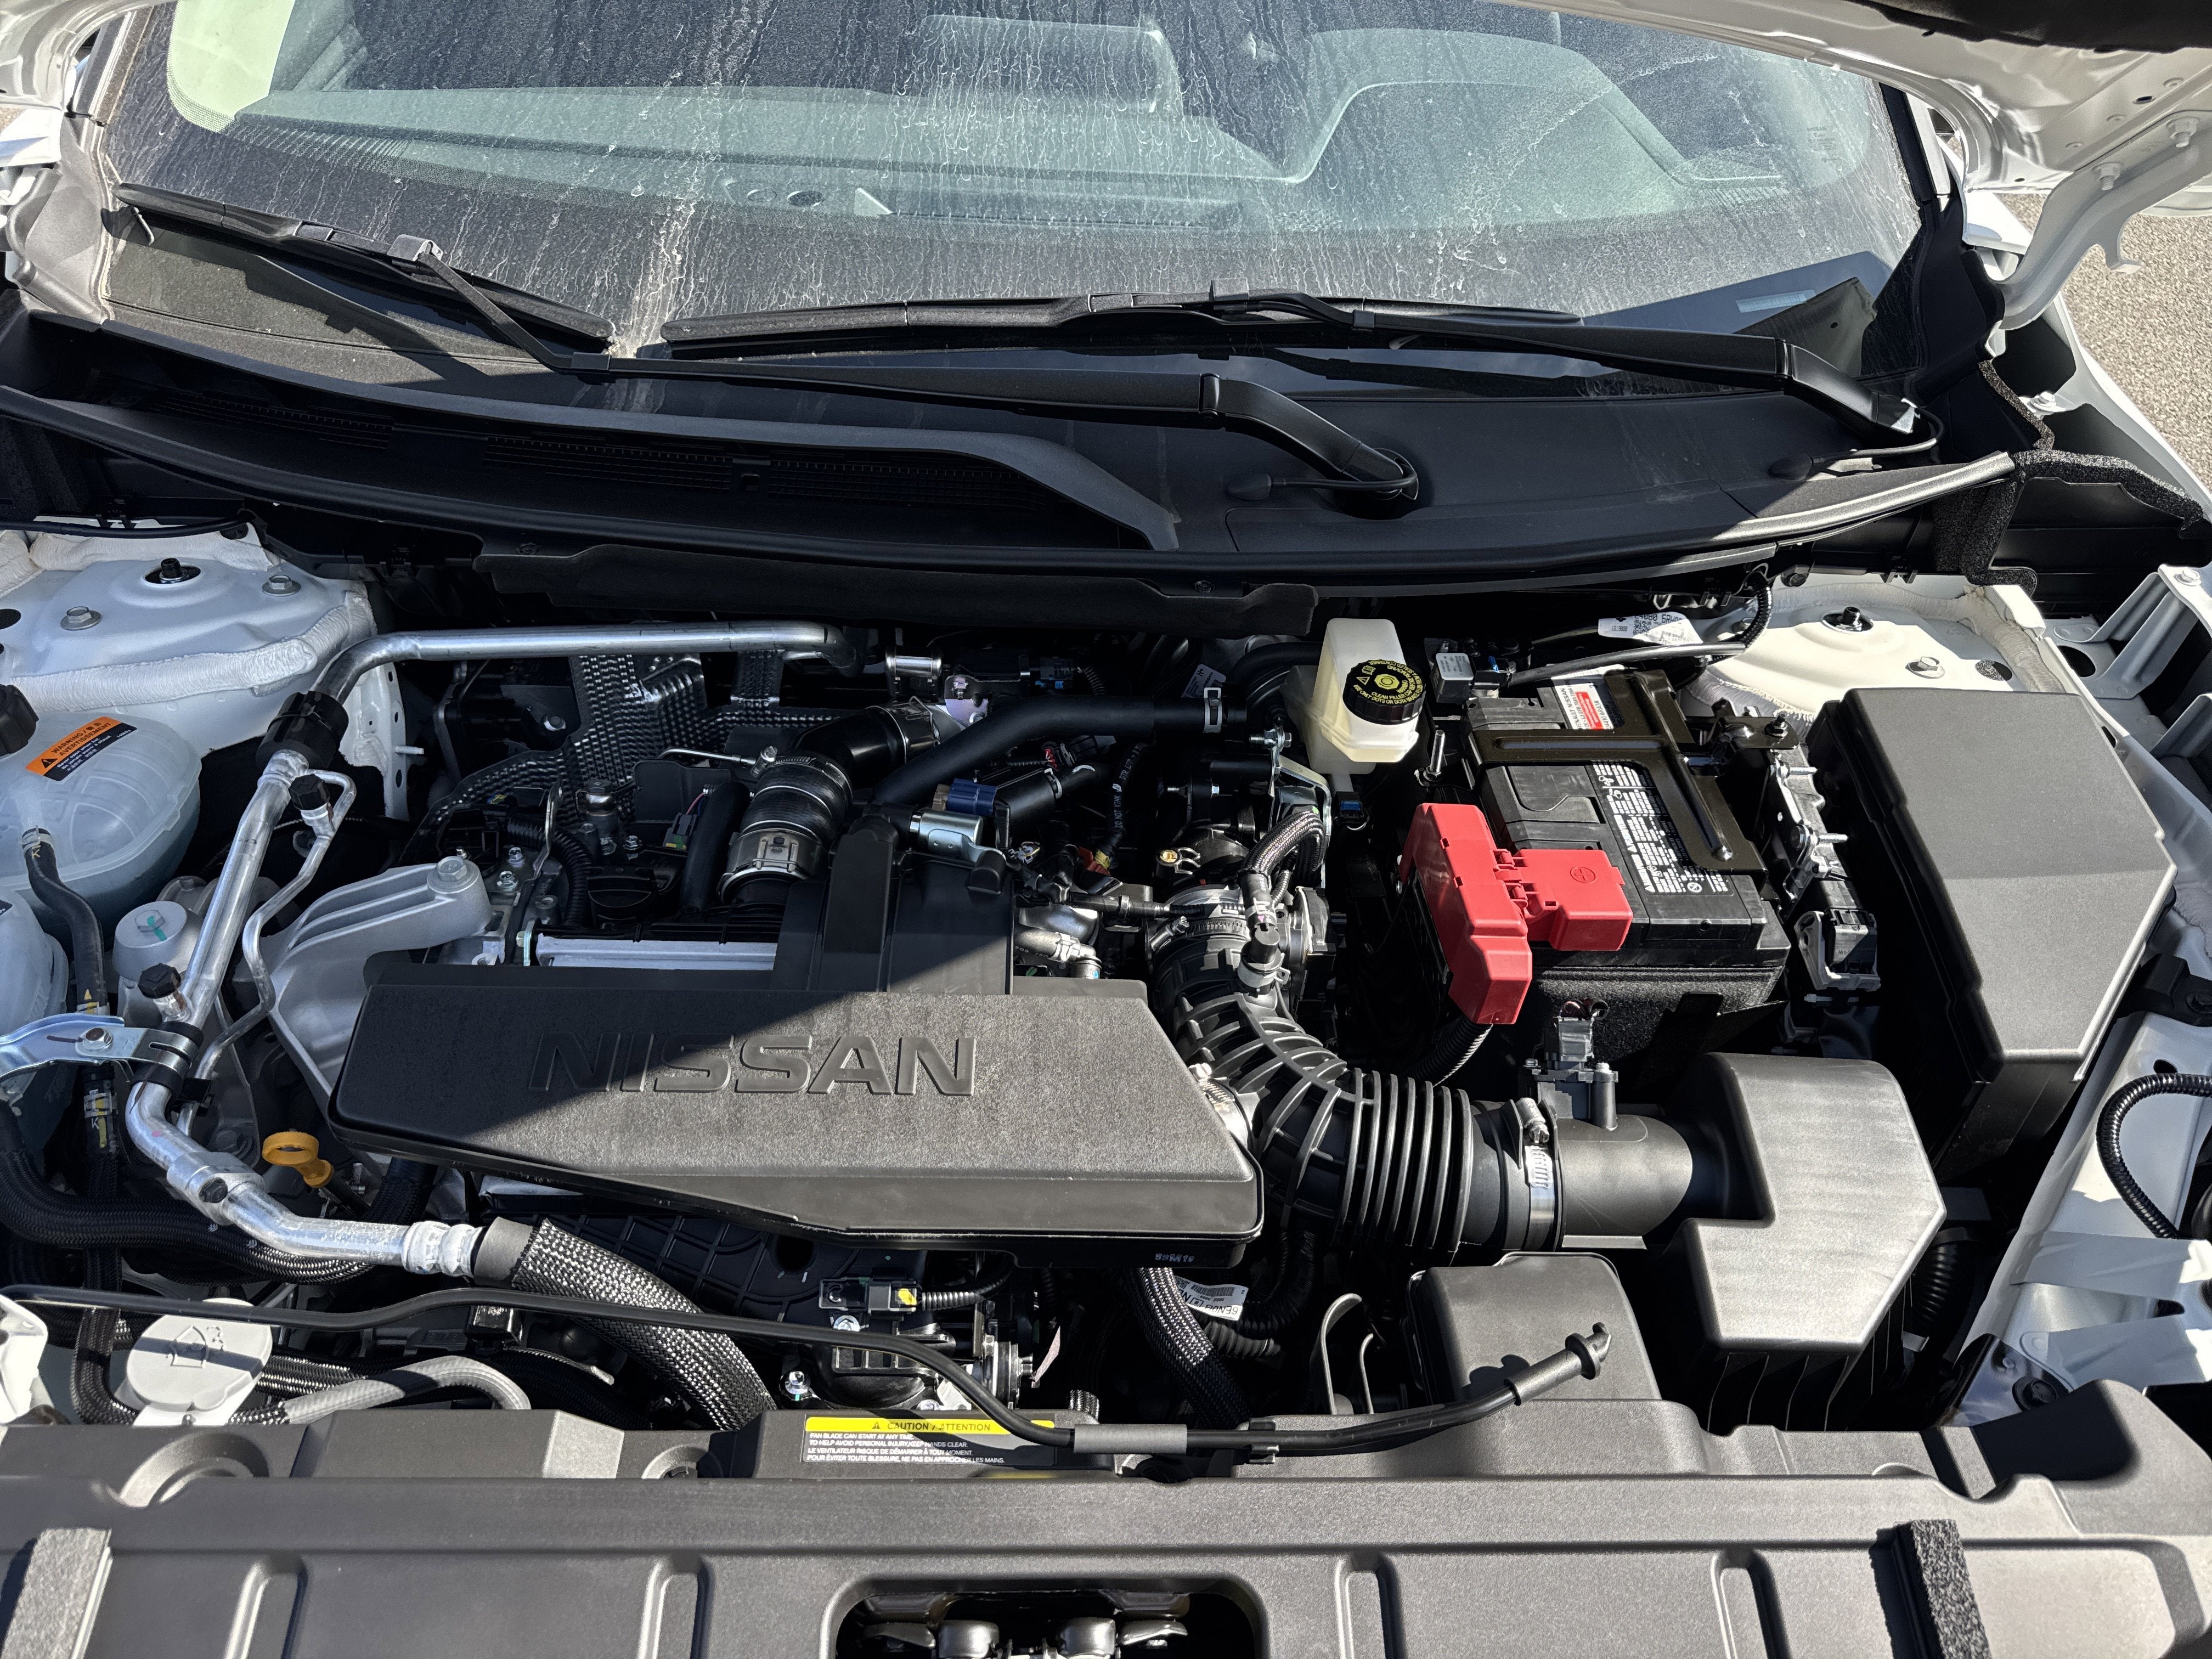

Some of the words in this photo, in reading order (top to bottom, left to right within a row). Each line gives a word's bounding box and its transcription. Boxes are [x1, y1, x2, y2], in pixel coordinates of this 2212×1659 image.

[1560, 688, 1572, 708] NISSAN
[51, 732, 83, 754] WARNING
[59, 722, 112, 756] AVERTISSEMENT
[70, 750, 81, 759] open
[80, 742, 93, 751] when
[1114, 809, 1122, 820] NOT
[528, 1032, 977, 1096] NISSAN
[91, 1117, 99, 1130] K
[887, 1421, 929, 1431] CAUTION
[938, 1423, 991, 1431] ATTENTION
